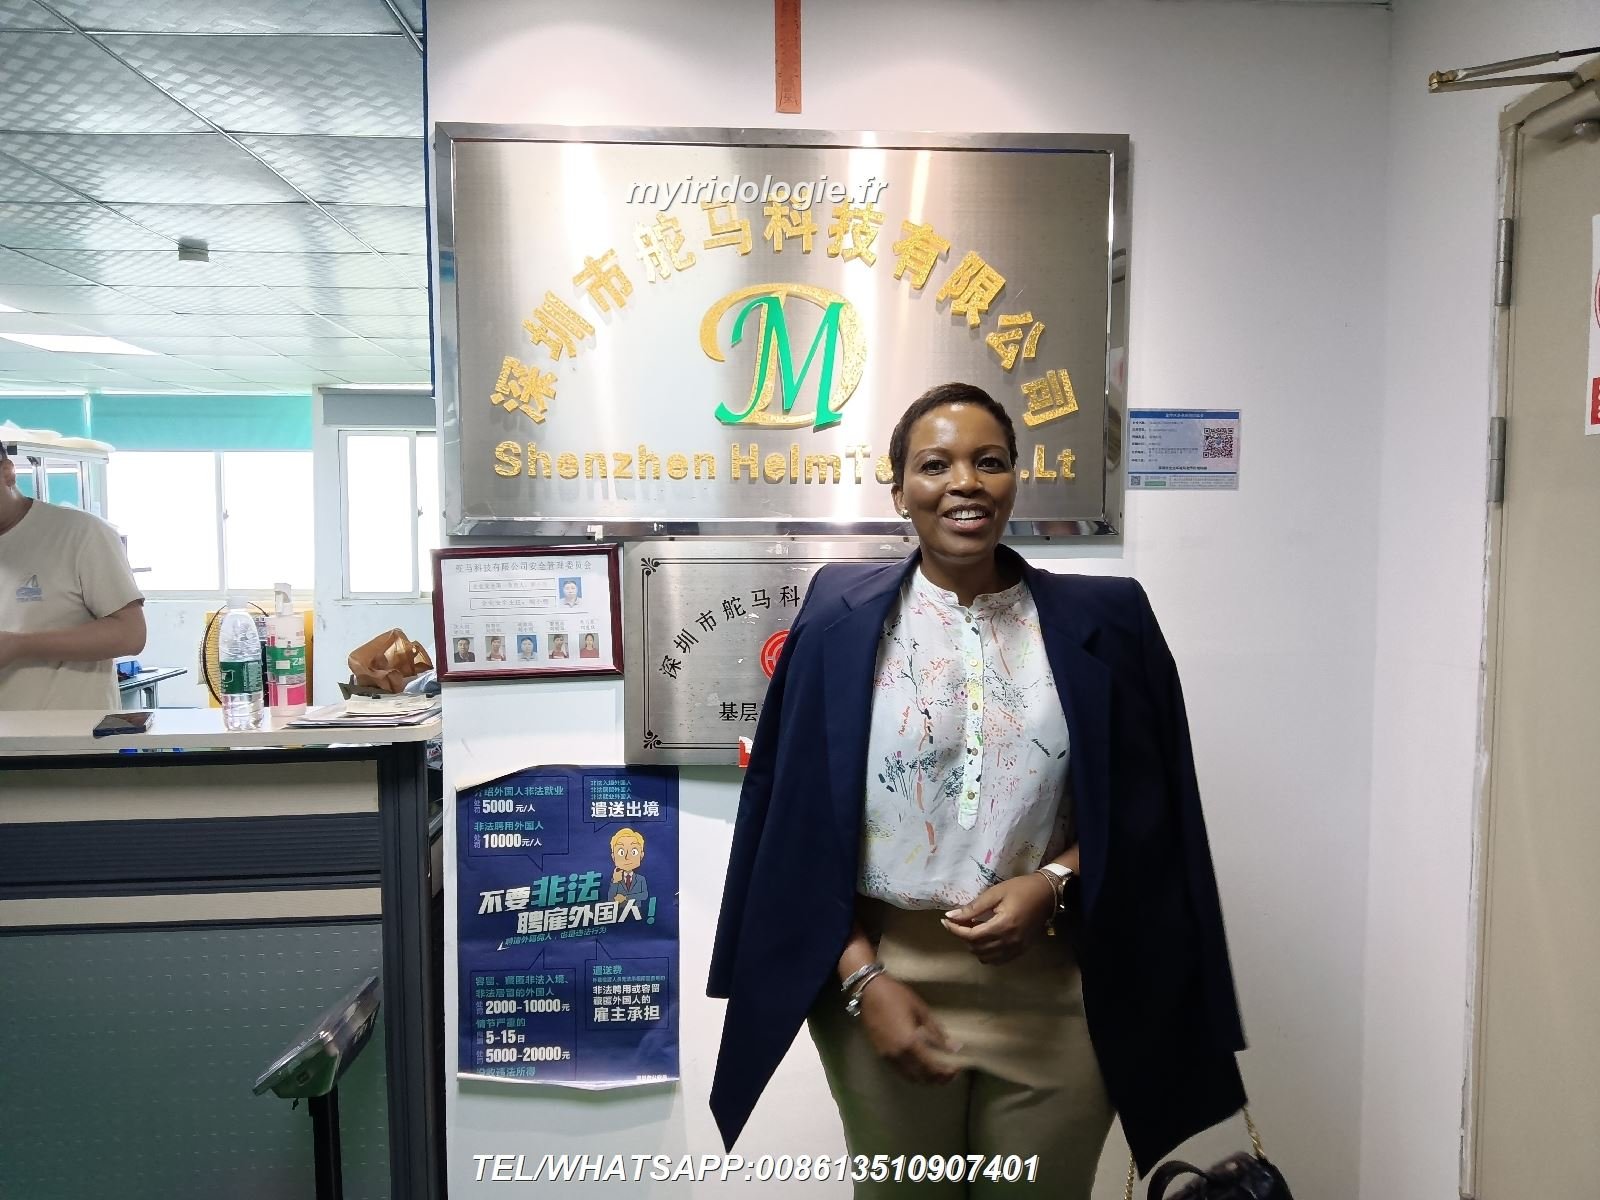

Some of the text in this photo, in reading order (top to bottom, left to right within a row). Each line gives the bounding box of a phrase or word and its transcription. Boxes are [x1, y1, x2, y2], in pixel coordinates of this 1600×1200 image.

[489, 196, 1079, 426] 深圳市舵马科技有限公司
[494, 440, 717, 482] Shenzhen
[718, 701, 759, 722] 基层
[591, 800, 660, 818] 遣送出境
[473, 820, 544, 832] 非法聘用外国人
[477, 870, 602, 915] 不要非法
[475, 986, 555, 999] 非法居留的外国人
[592, 983, 660, 995] 非法聘用或容留
[593, 1005, 661, 1023] 雇主承担
